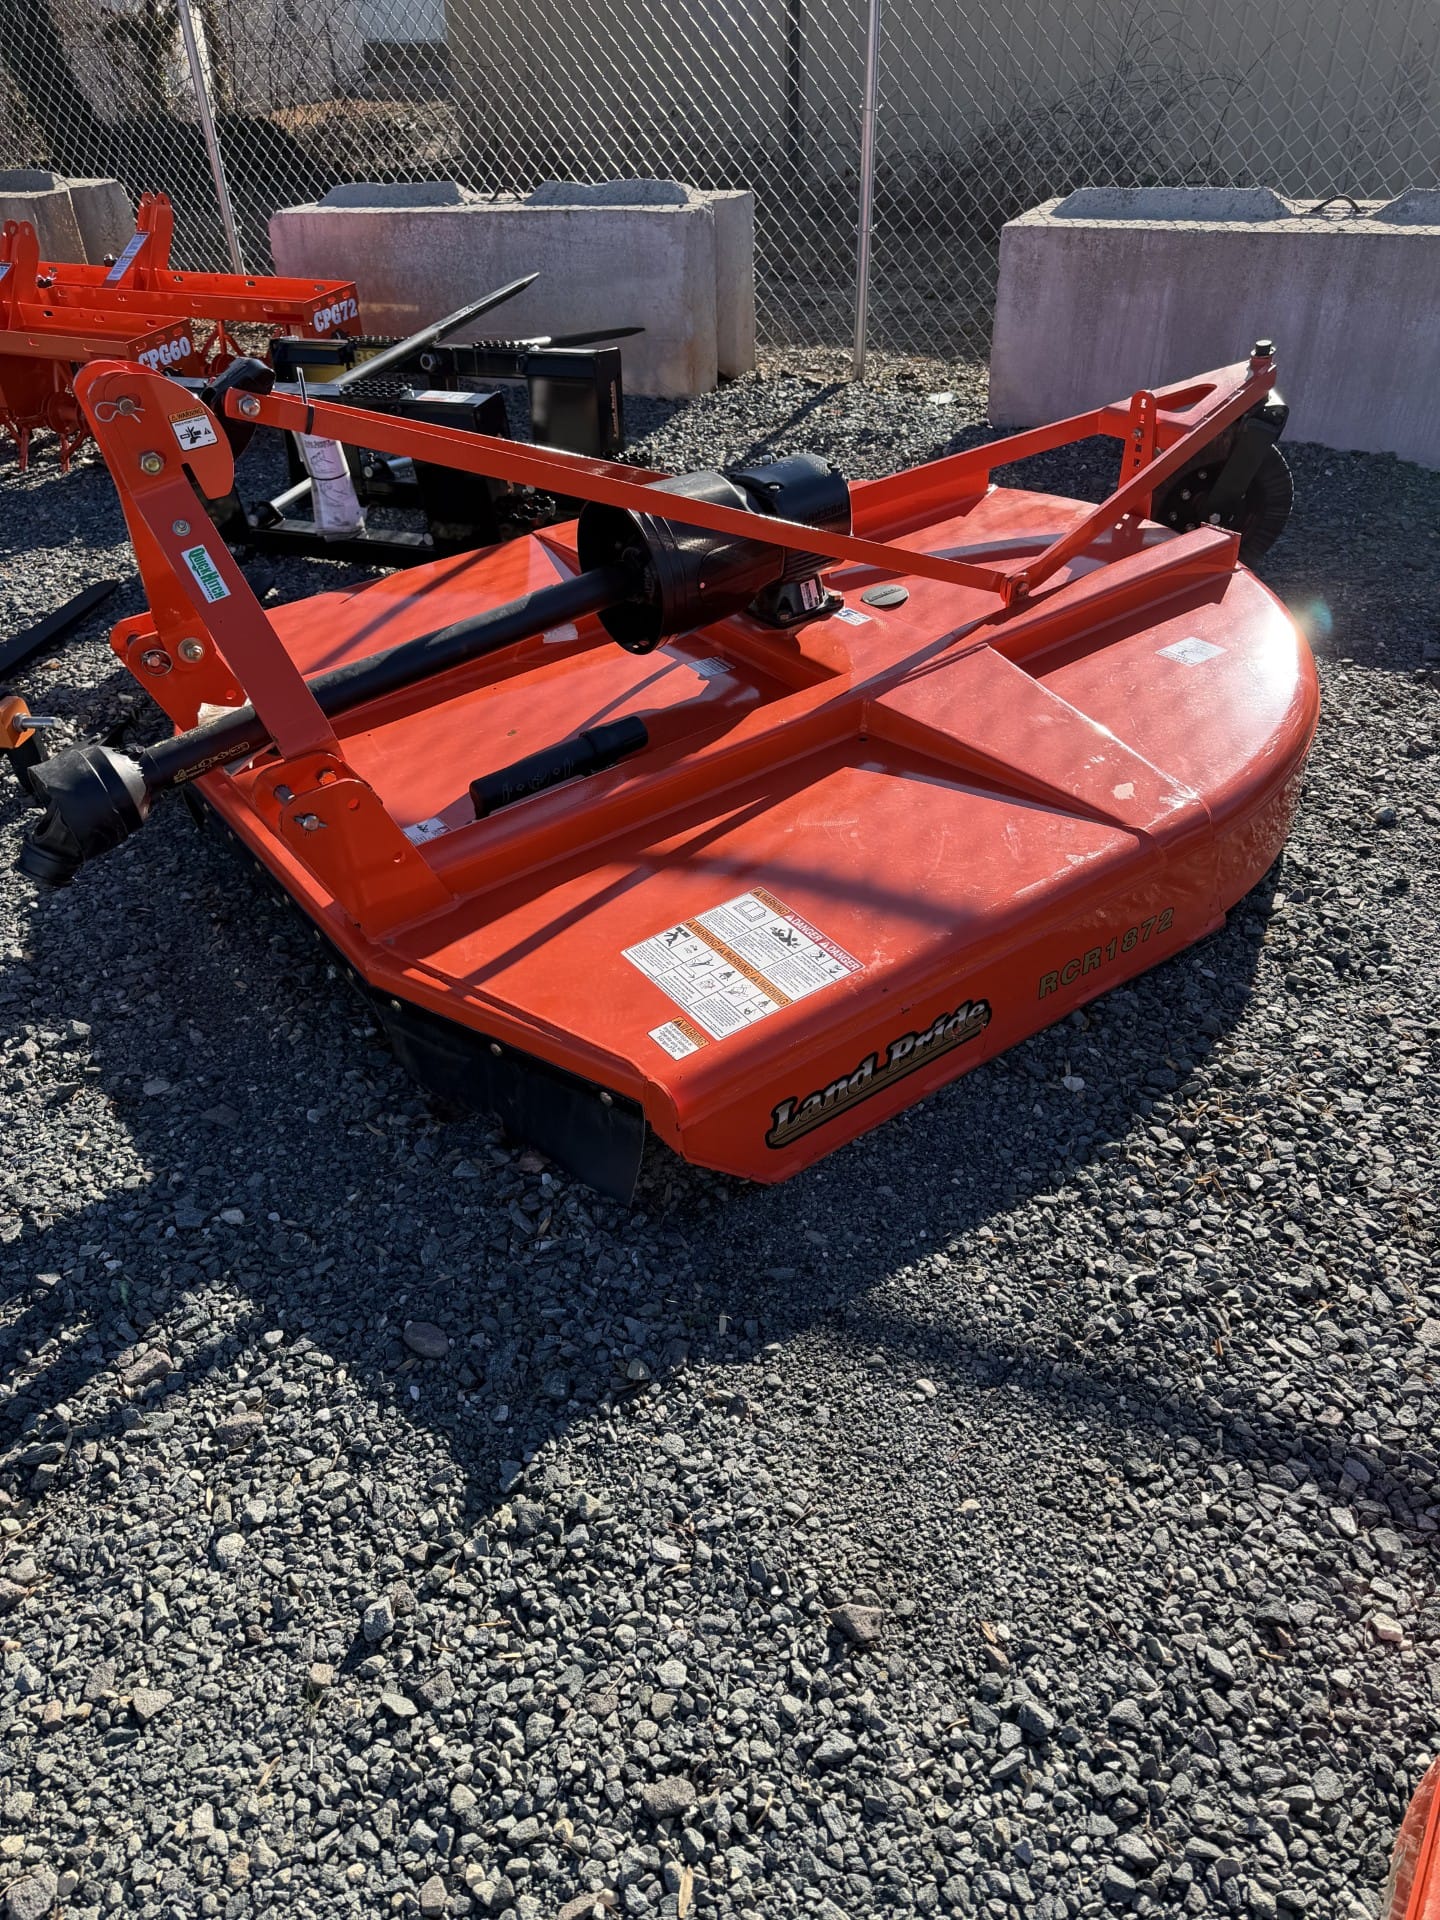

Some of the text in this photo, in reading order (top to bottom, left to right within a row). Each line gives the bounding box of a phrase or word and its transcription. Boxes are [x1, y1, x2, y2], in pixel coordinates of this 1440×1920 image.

[313, 298, 358, 332] CPG72
[138, 336, 191, 370] CPG60
[758, 893, 789, 914] WARNING
[691, 924, 720, 947] WARNING
[790, 917, 824, 942] DANGER
[722, 951, 753, 975] WARNING
[825, 945, 860, 970] DANGER
[1038, 906, 1175, 1000] RCR1872
[756, 979, 790, 1005] WARNING
[771, 1000, 990, 1138] Land Pride
